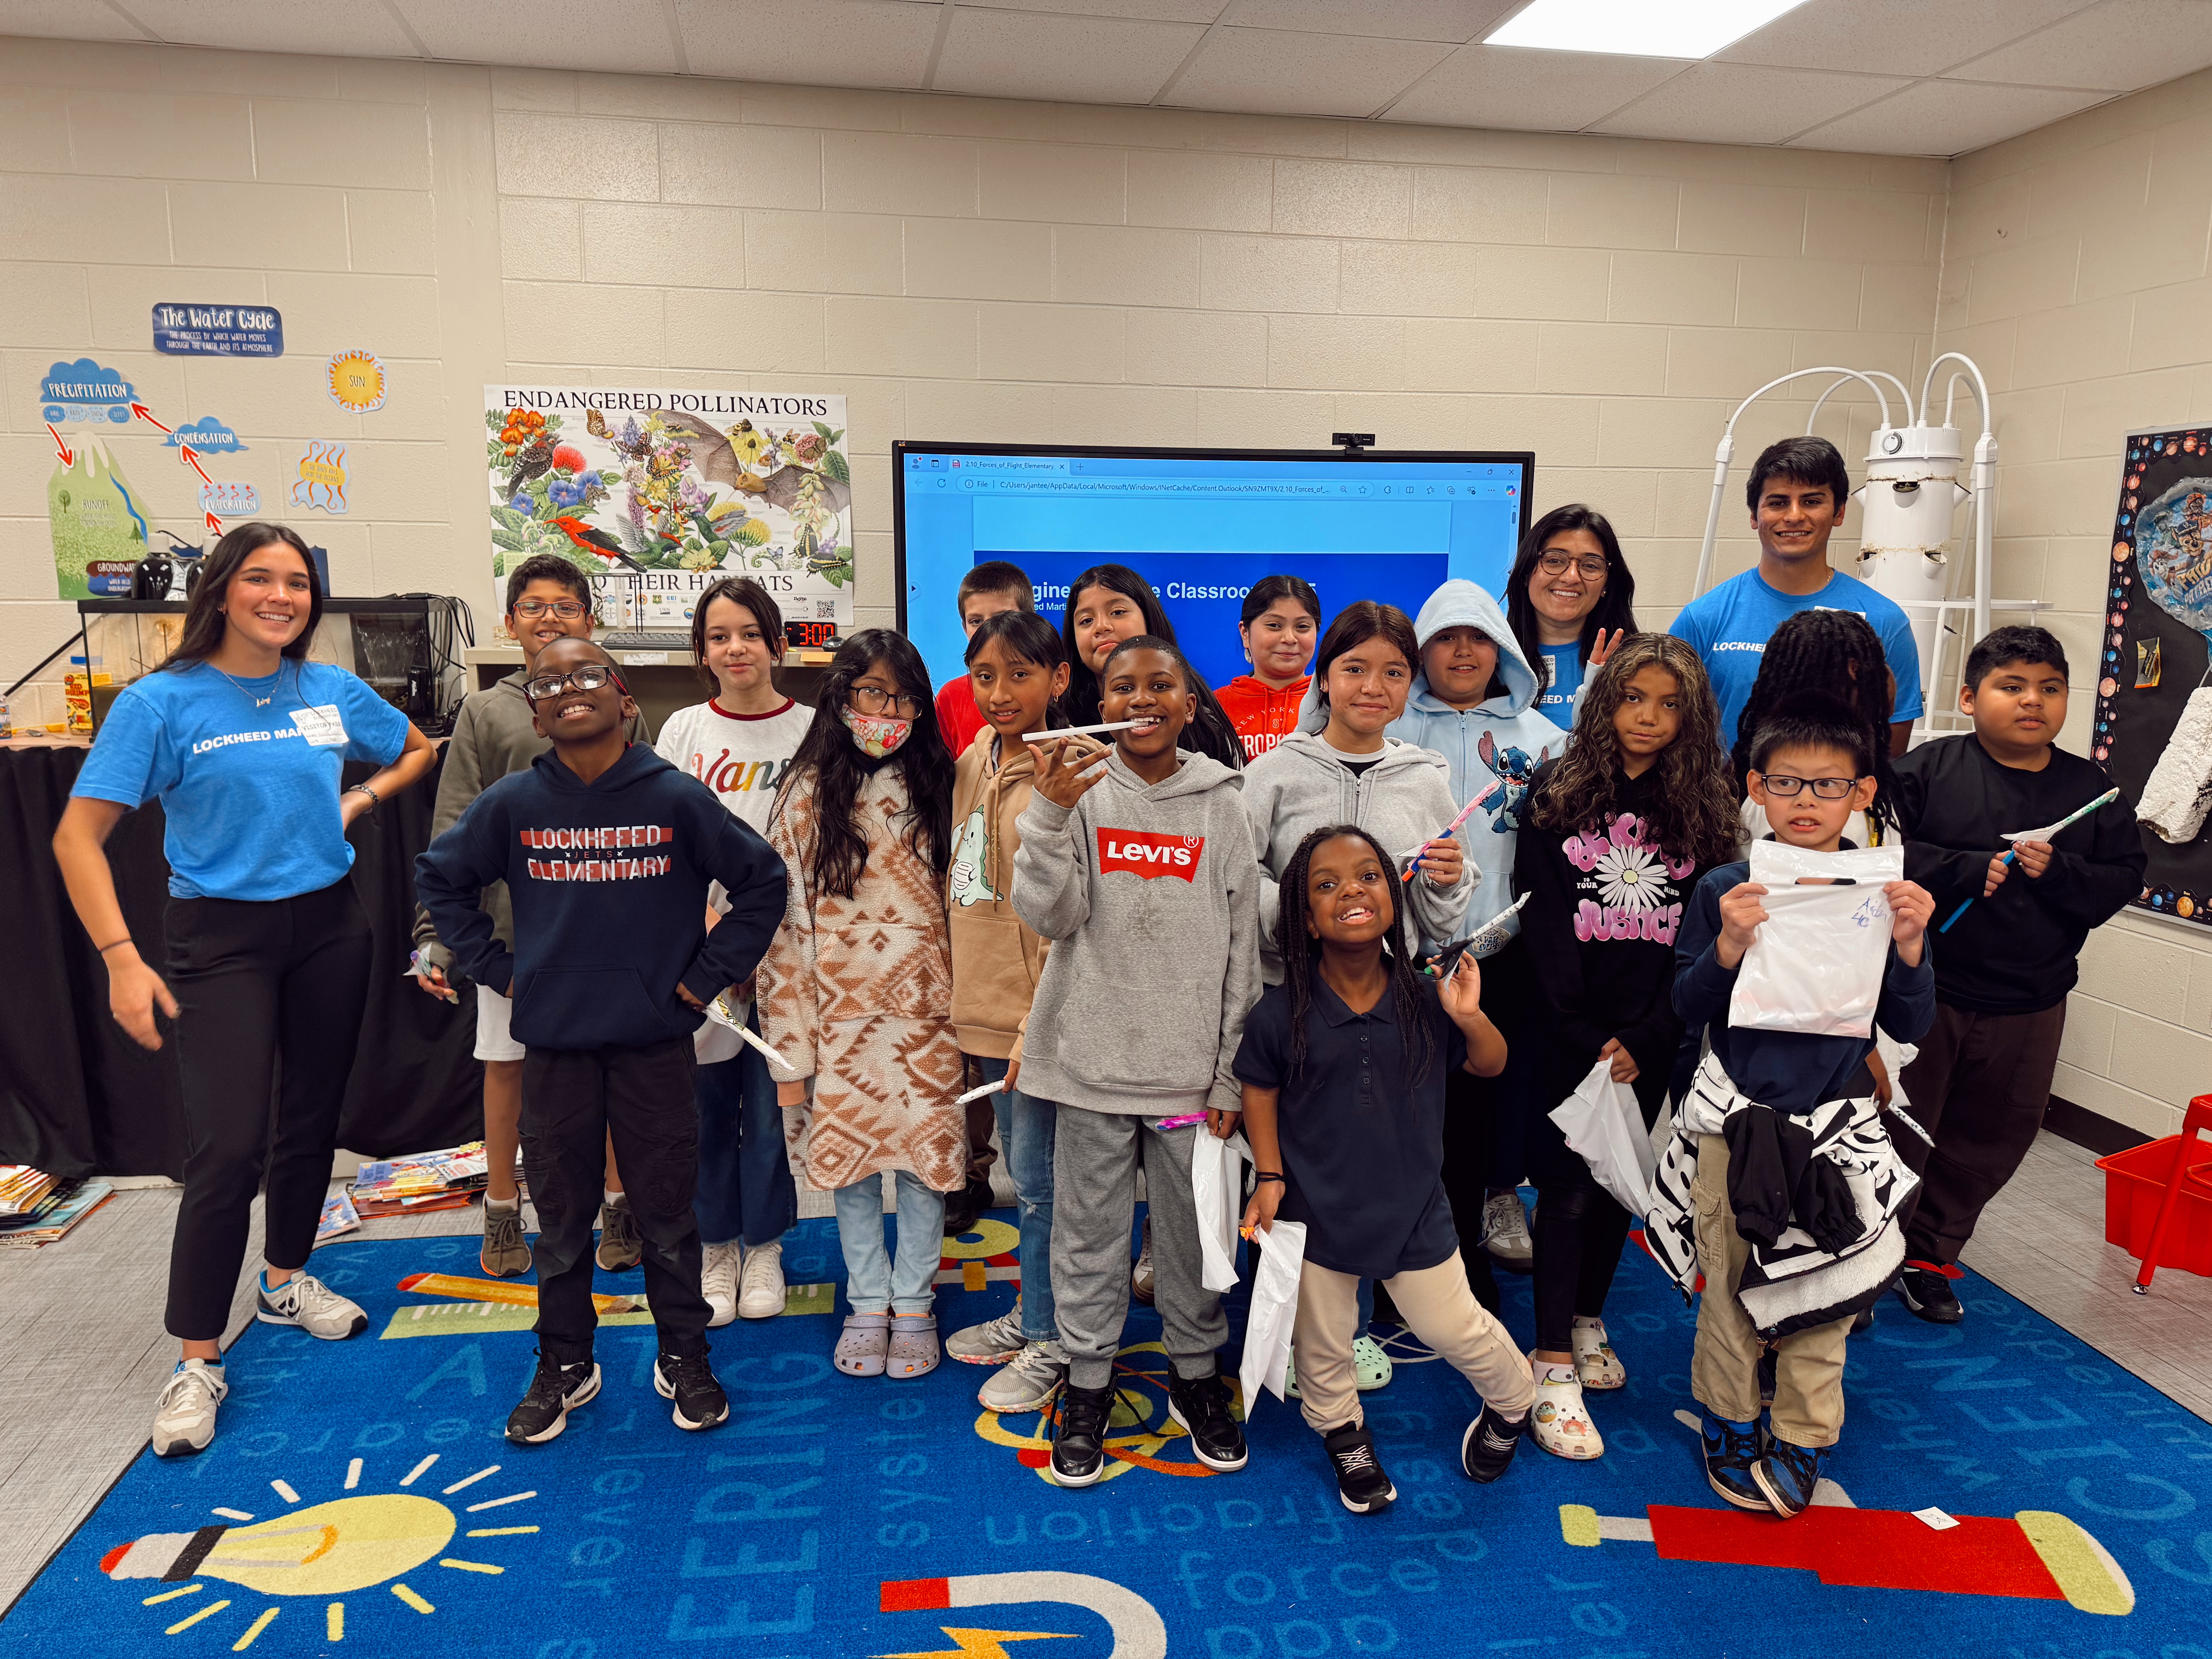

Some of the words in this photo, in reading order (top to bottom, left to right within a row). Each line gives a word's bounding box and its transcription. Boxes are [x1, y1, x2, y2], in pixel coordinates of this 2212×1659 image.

[161, 307, 185, 327] The
[189, 308, 233, 328] Water
[238, 311, 274, 330] Cycle
[169, 331, 178, 339] THE
[180, 331, 201, 340] PROCESS
[203, 332, 210, 340] BY
[212, 332, 228, 341] WHICH
[230, 333, 247, 342] WATER
[248, 333, 266, 342] MOVES
[166, 340, 189, 349] THROUGH
[192, 341, 201, 350] THE
[203, 342, 217, 350] EARTH
[220, 342, 230, 351] AND
[242, 343, 273, 352] ATMOSPHERE
[349, 375, 365, 388] SUN
[48, 383, 127, 398] PRECIPITATION
[504, 390, 662, 410] ENDANGERED
[669, 394, 827, 417] POLLINATORS
[174, 432, 233, 444] CONDENSATION
[83, 499, 110, 510] RUNOFF
[205, 498, 256, 510] EVAPORATION
[616, 574, 683, 590] HEIR
[689, 574, 793, 591] HAATS
[1167, 582, 1253, 599] Classroo
[302, 722, 327, 731] VISITOR
[1235, 714, 1255, 731] NEW
[1261, 707, 1295, 715] YORK
[193, 731, 271, 754] LOCKHEED
[528, 855, 669, 882] ELEMENTARY
[1664, 886, 1680, 896] MIND
[1573, 898, 1683, 946] JUSTICE
[866, 1378, 953, 1549] syste
[1175, 1549, 1441, 1609] force
